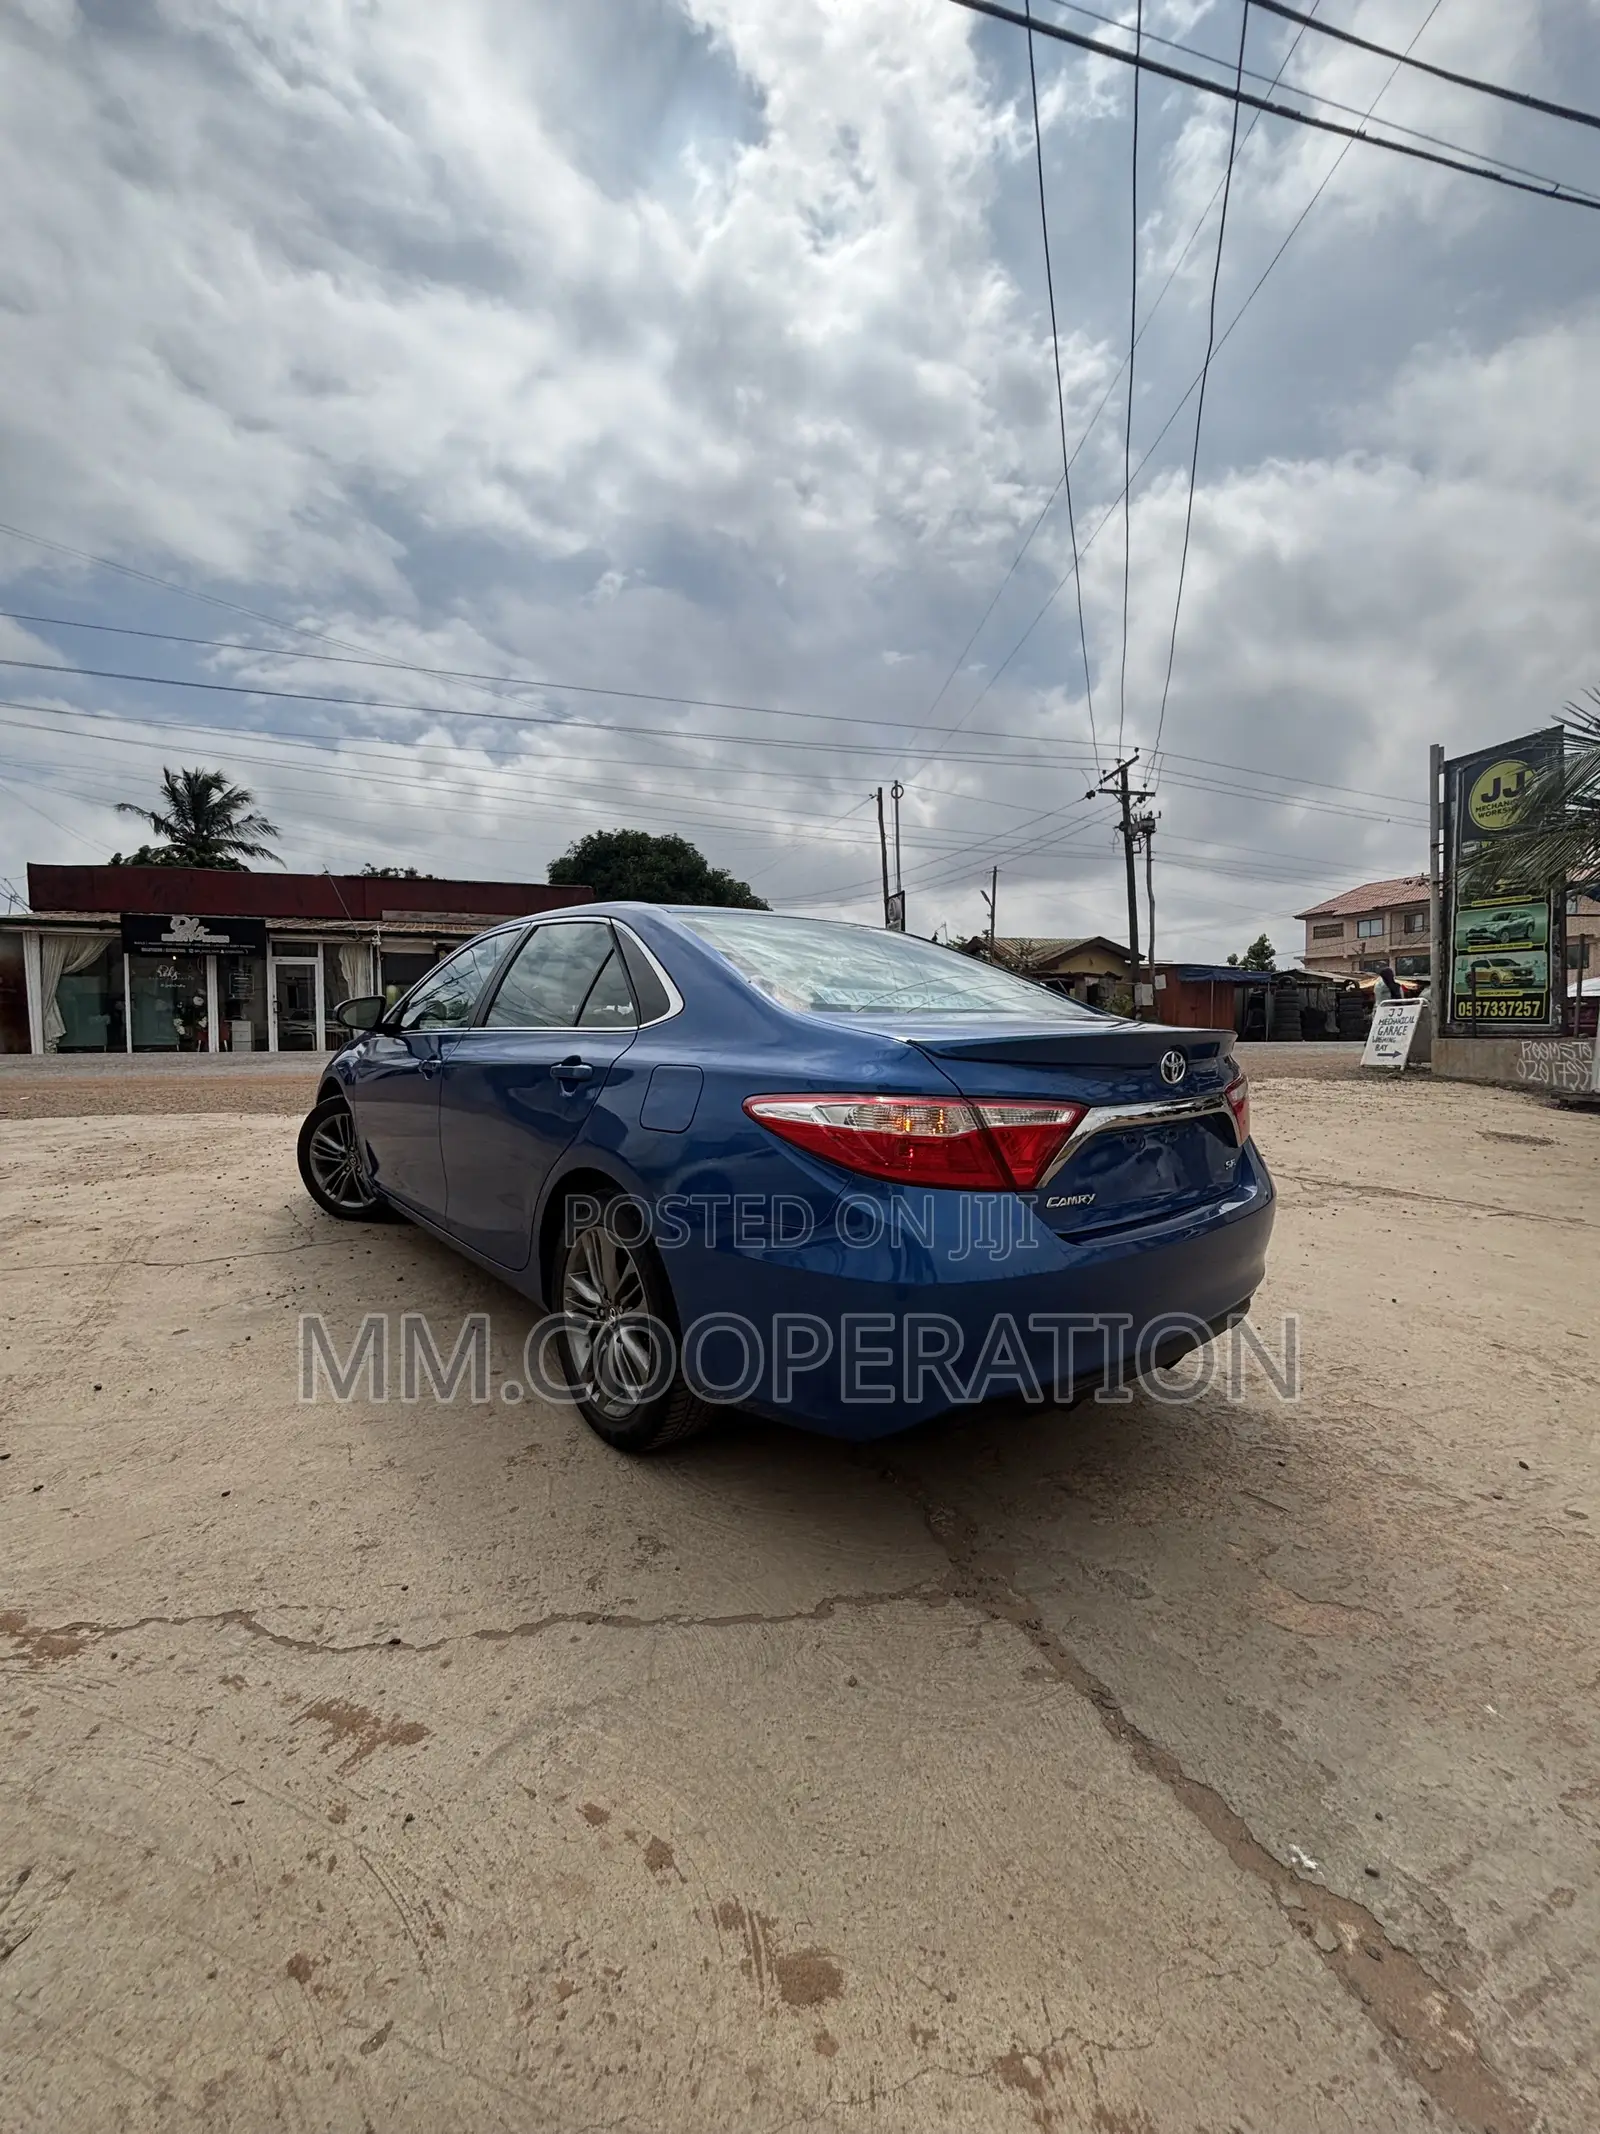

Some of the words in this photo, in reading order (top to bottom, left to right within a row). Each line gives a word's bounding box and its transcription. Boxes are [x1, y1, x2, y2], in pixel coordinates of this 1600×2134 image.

[1481, 771, 1526, 803] JJ
[1458, 1001, 1541, 1017] 0557337257
[1377, 1025, 1408, 1036] GARAGE
[1046, 1193, 1096, 1208] CAMRY
